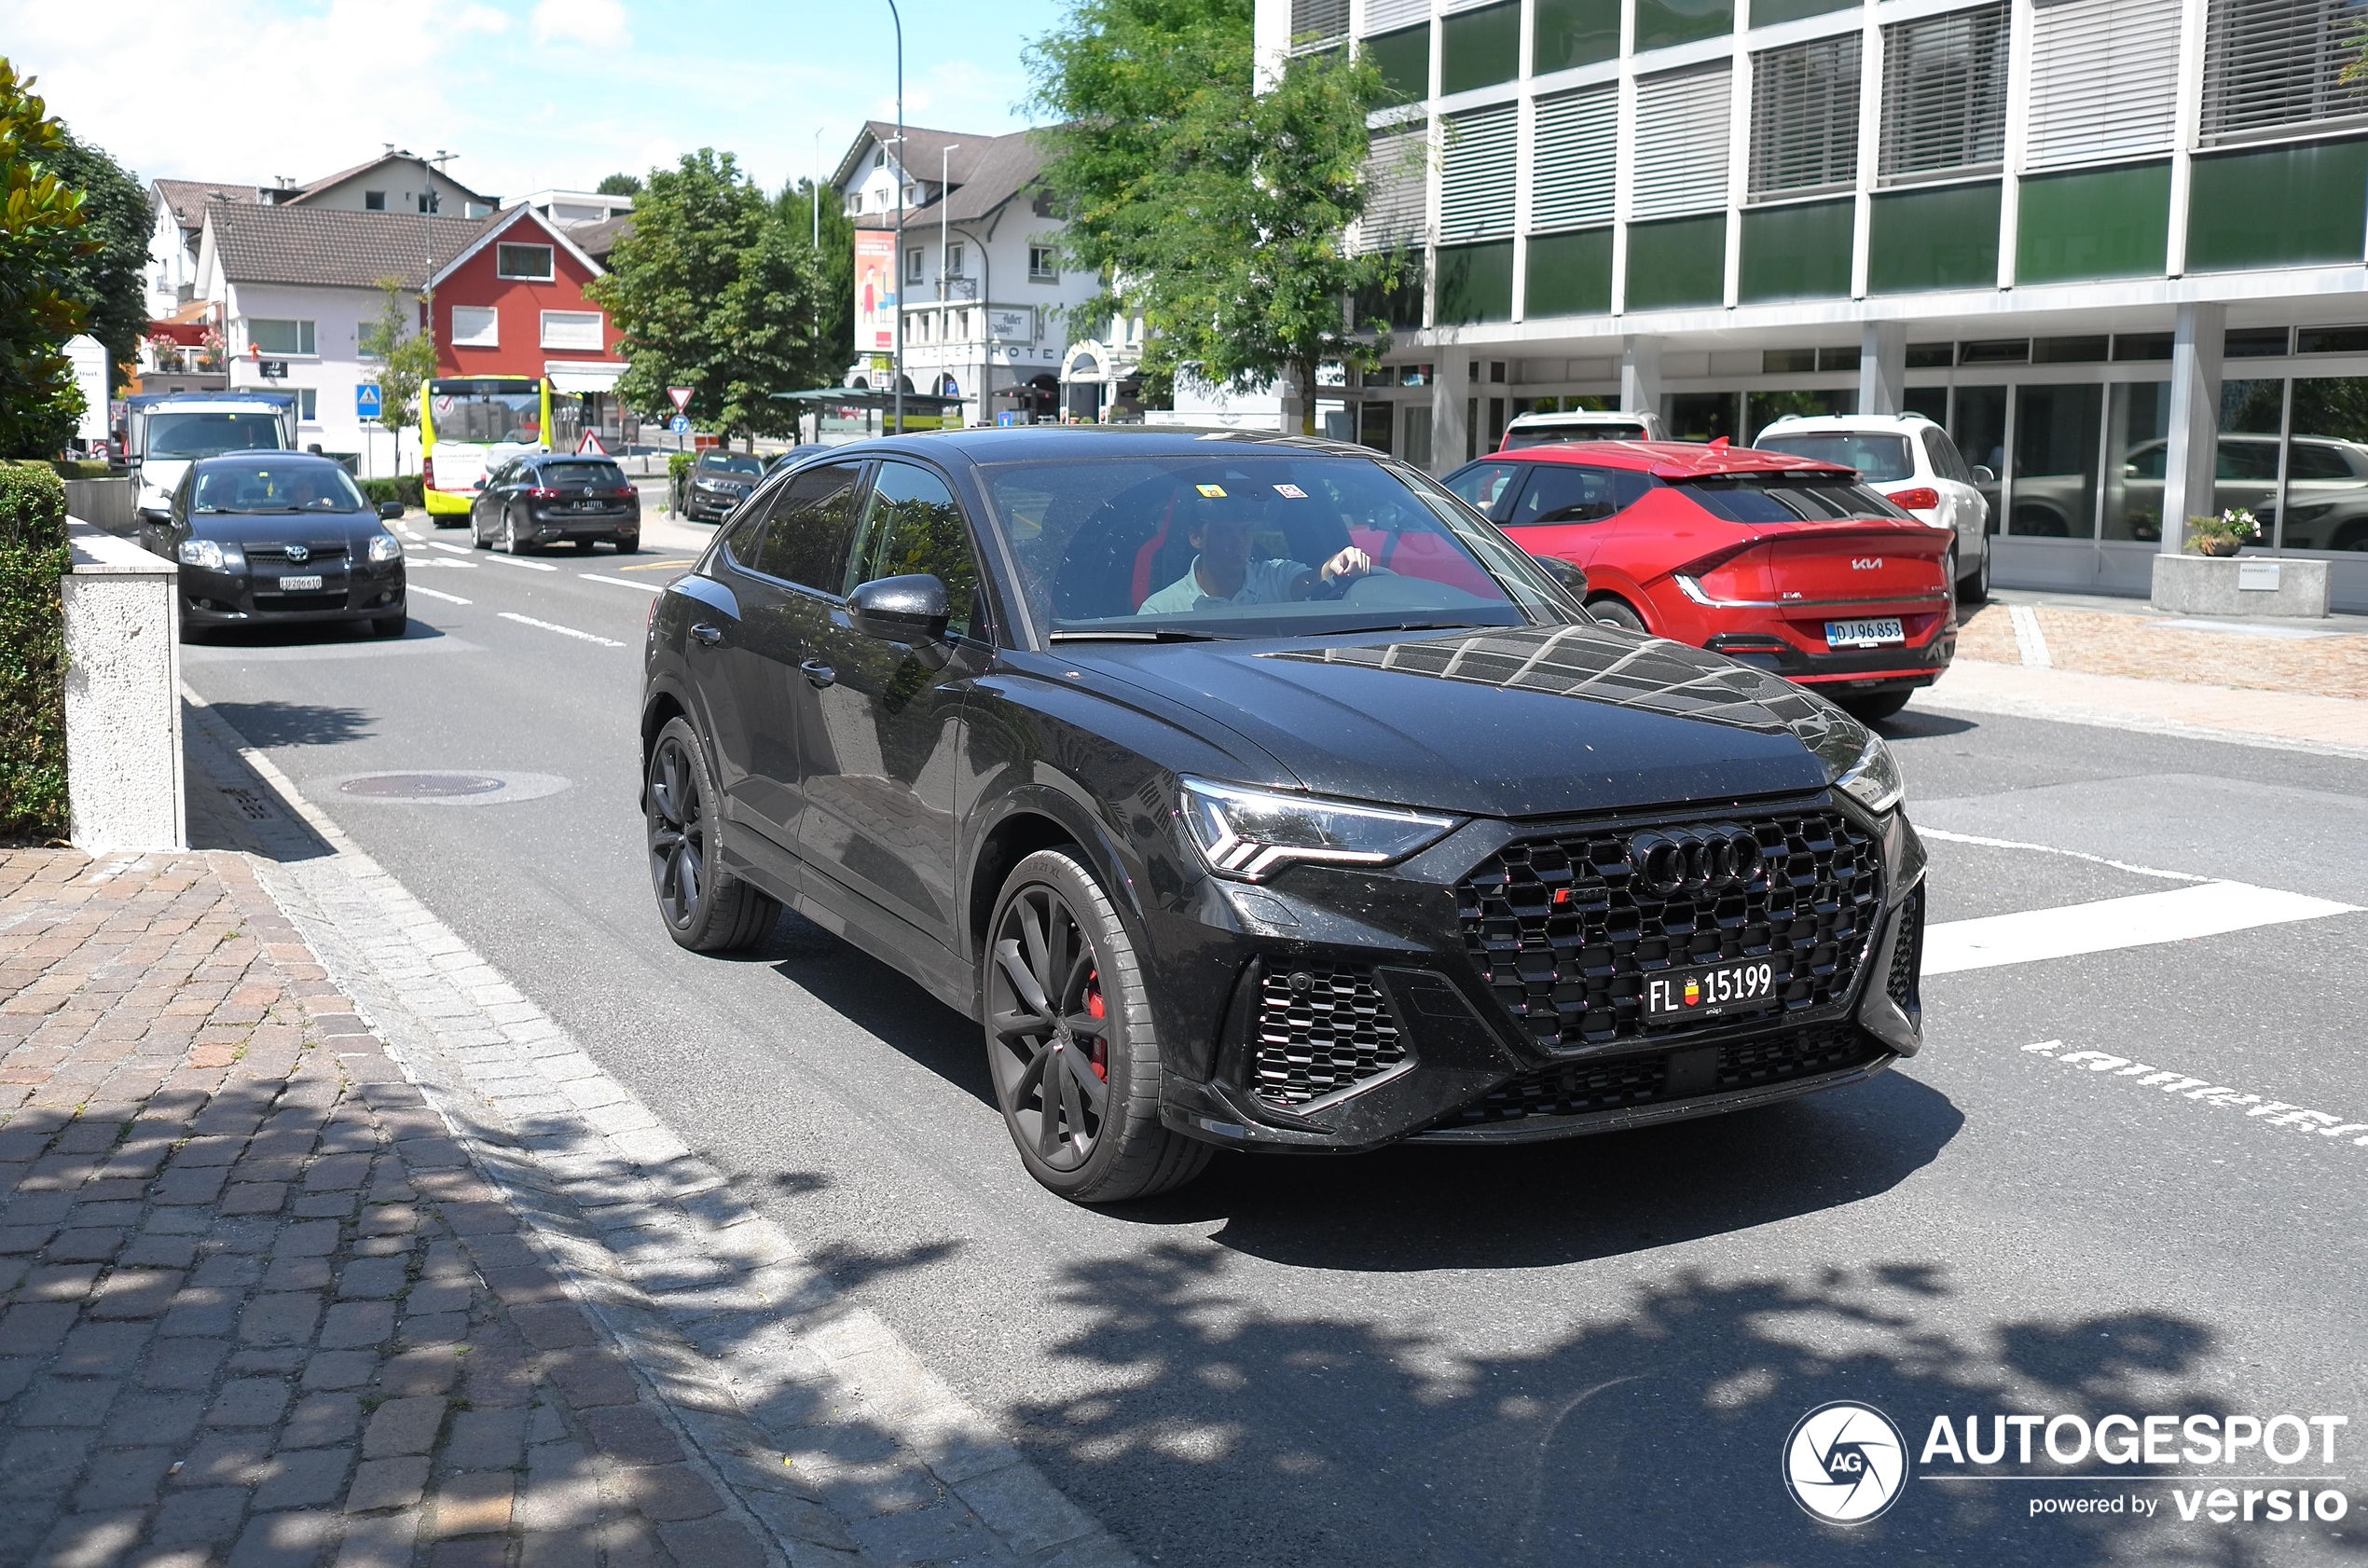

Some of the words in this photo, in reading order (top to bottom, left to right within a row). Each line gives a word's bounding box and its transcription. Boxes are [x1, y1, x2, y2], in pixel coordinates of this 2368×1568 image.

[949, 383, 956, 392] P
[1852, 557, 1883, 570] KIA
[1649, 980, 1679, 1012] FL
[1704, 963, 1771, 1004] 15199
